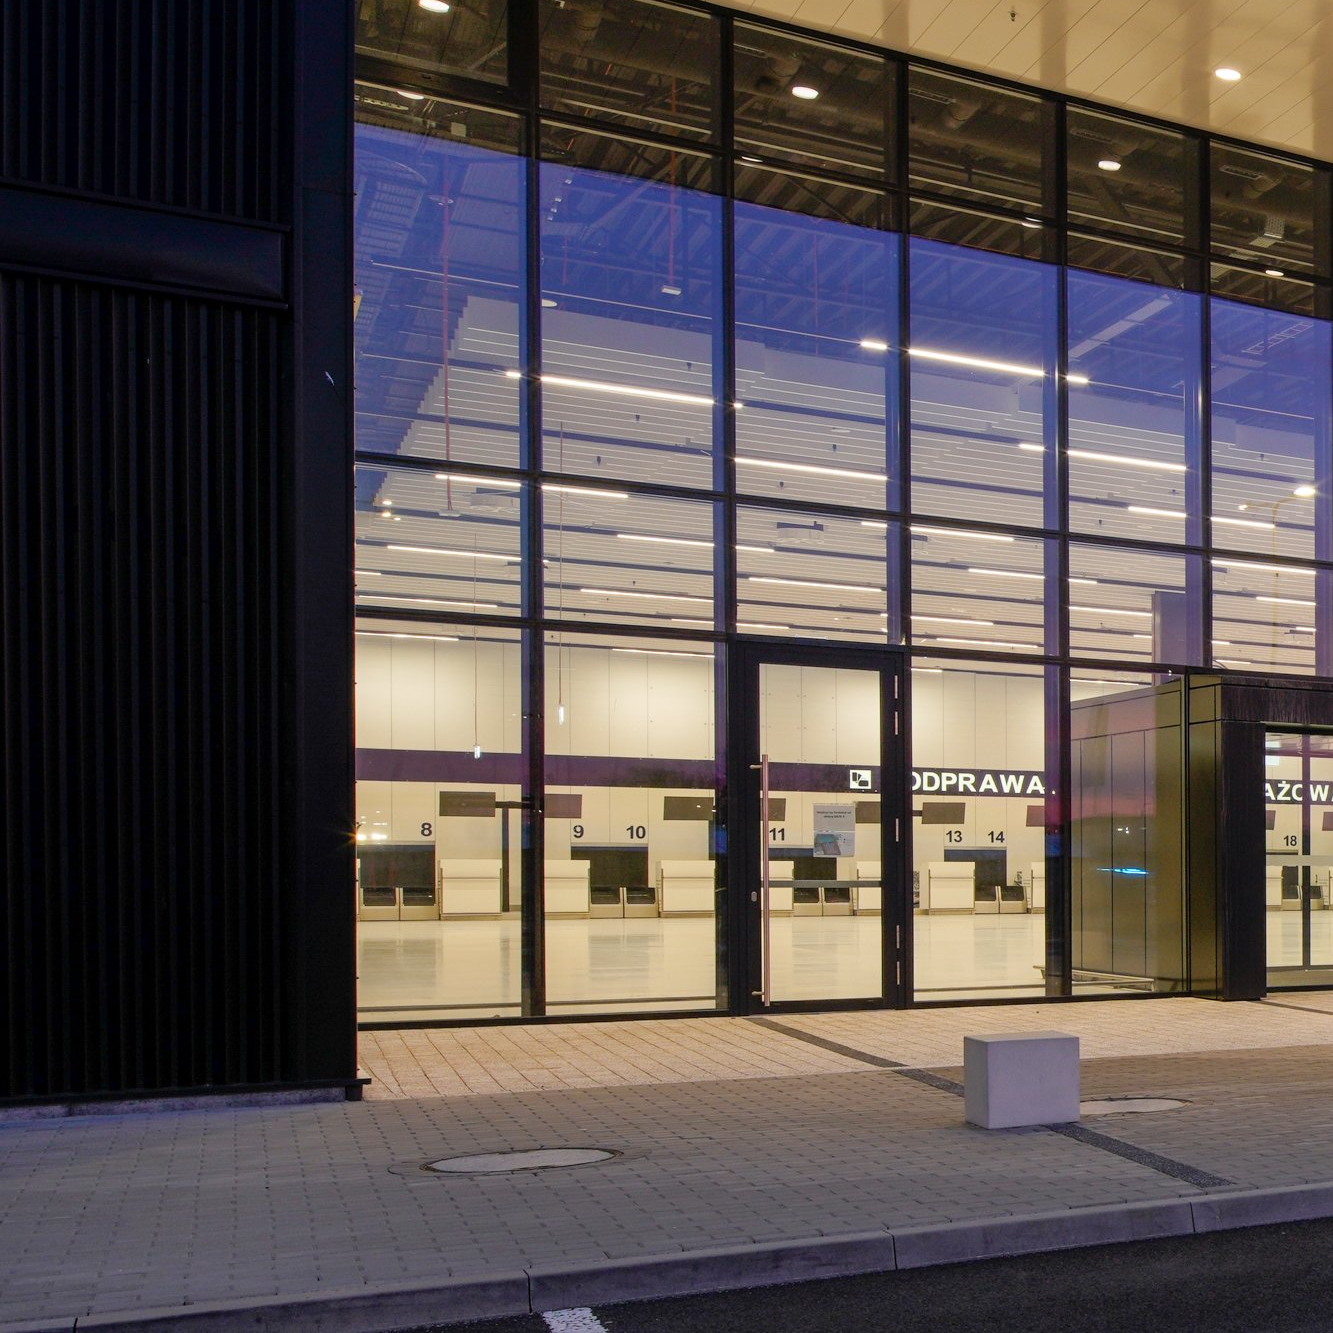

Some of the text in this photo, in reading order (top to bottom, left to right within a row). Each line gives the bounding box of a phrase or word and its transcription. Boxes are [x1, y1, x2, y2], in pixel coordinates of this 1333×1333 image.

[420, 822, 433, 837] 8
[572, 824, 584, 839] 9
[626, 825, 647, 840] 10
[769, 828, 786, 841] 11
[945, 830, 963, 843] 13
[987, 830, 1005, 843] 14
[1283, 835, 1298, 847] 18
